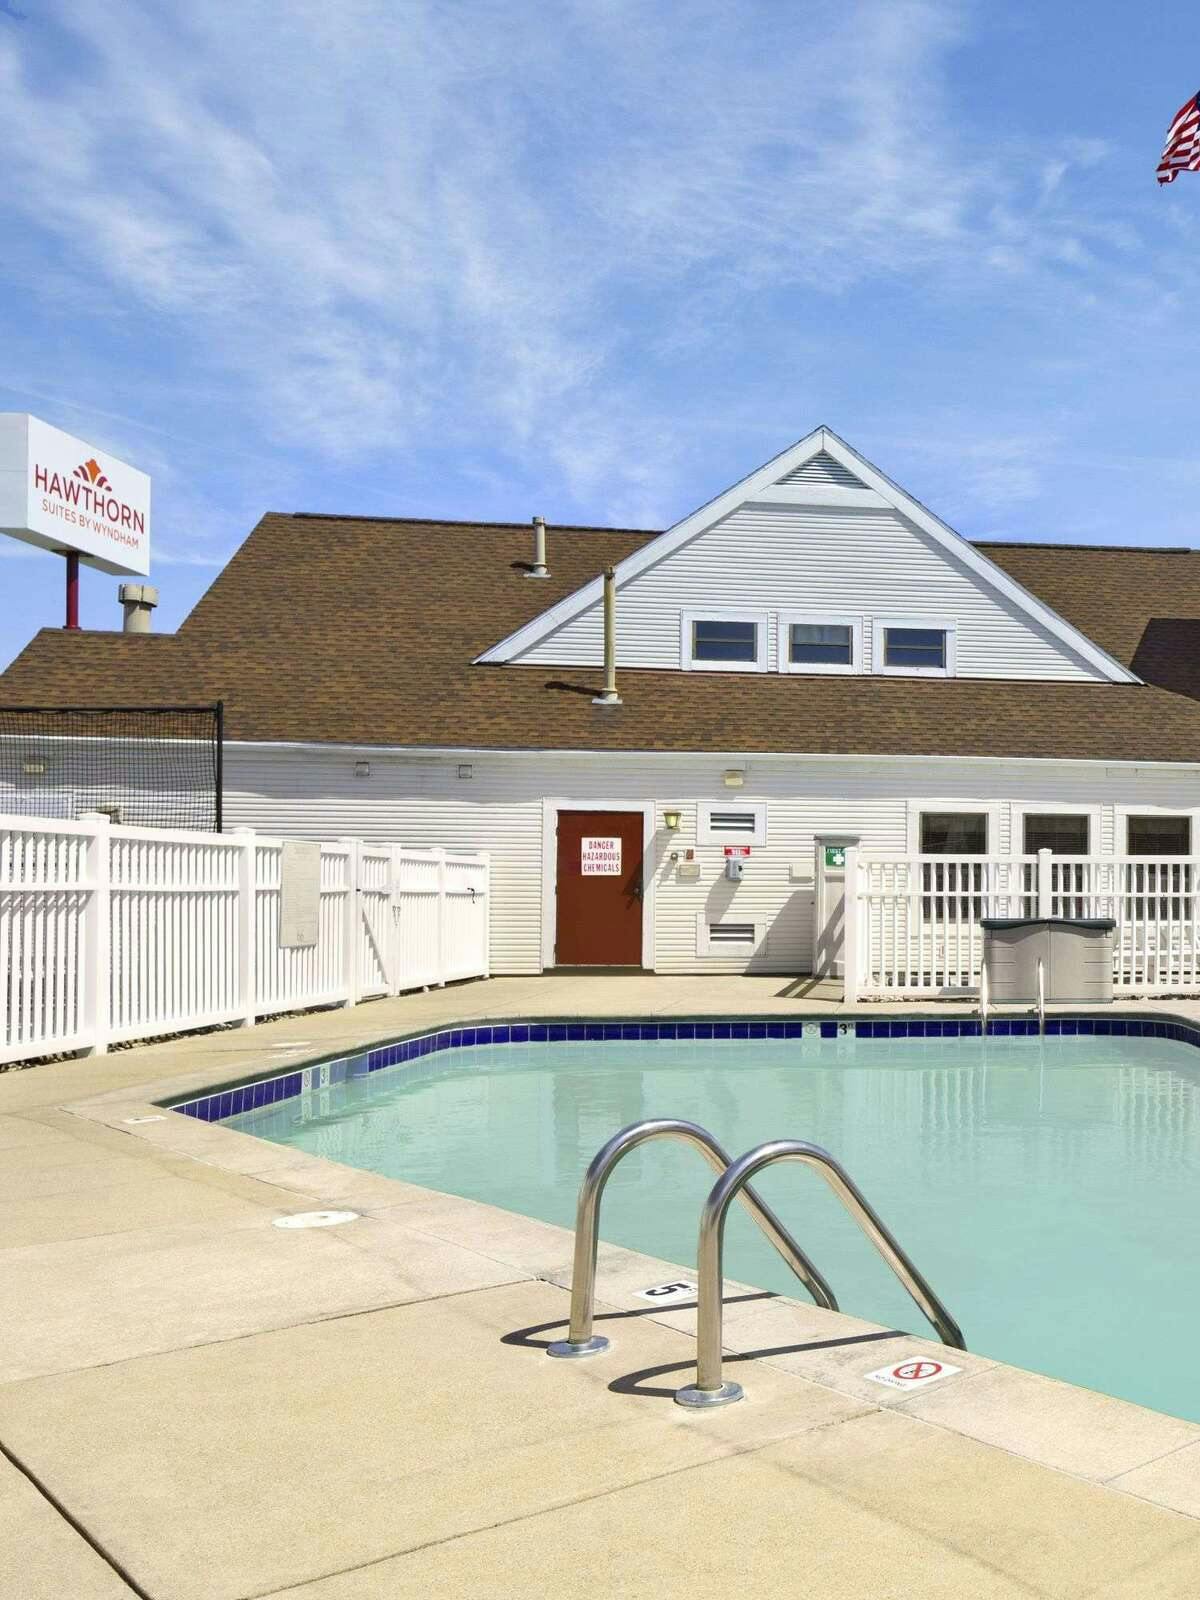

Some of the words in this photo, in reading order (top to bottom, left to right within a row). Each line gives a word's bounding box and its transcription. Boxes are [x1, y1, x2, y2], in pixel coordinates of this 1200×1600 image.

[35, 463, 144, 534] HAWTHORN
[42, 499, 76, 523] SUITES
[79, 514, 91, 529] BY
[92, 521, 139, 548] WYNDHAM
[588, 840, 614, 850] DANGER
[582, 851, 620, 861] HAZARDOUS
[583, 863, 620, 873] CHEMICALS
[839, 1023, 848, 1036] 3
[645, 1283, 690, 1296] 5
